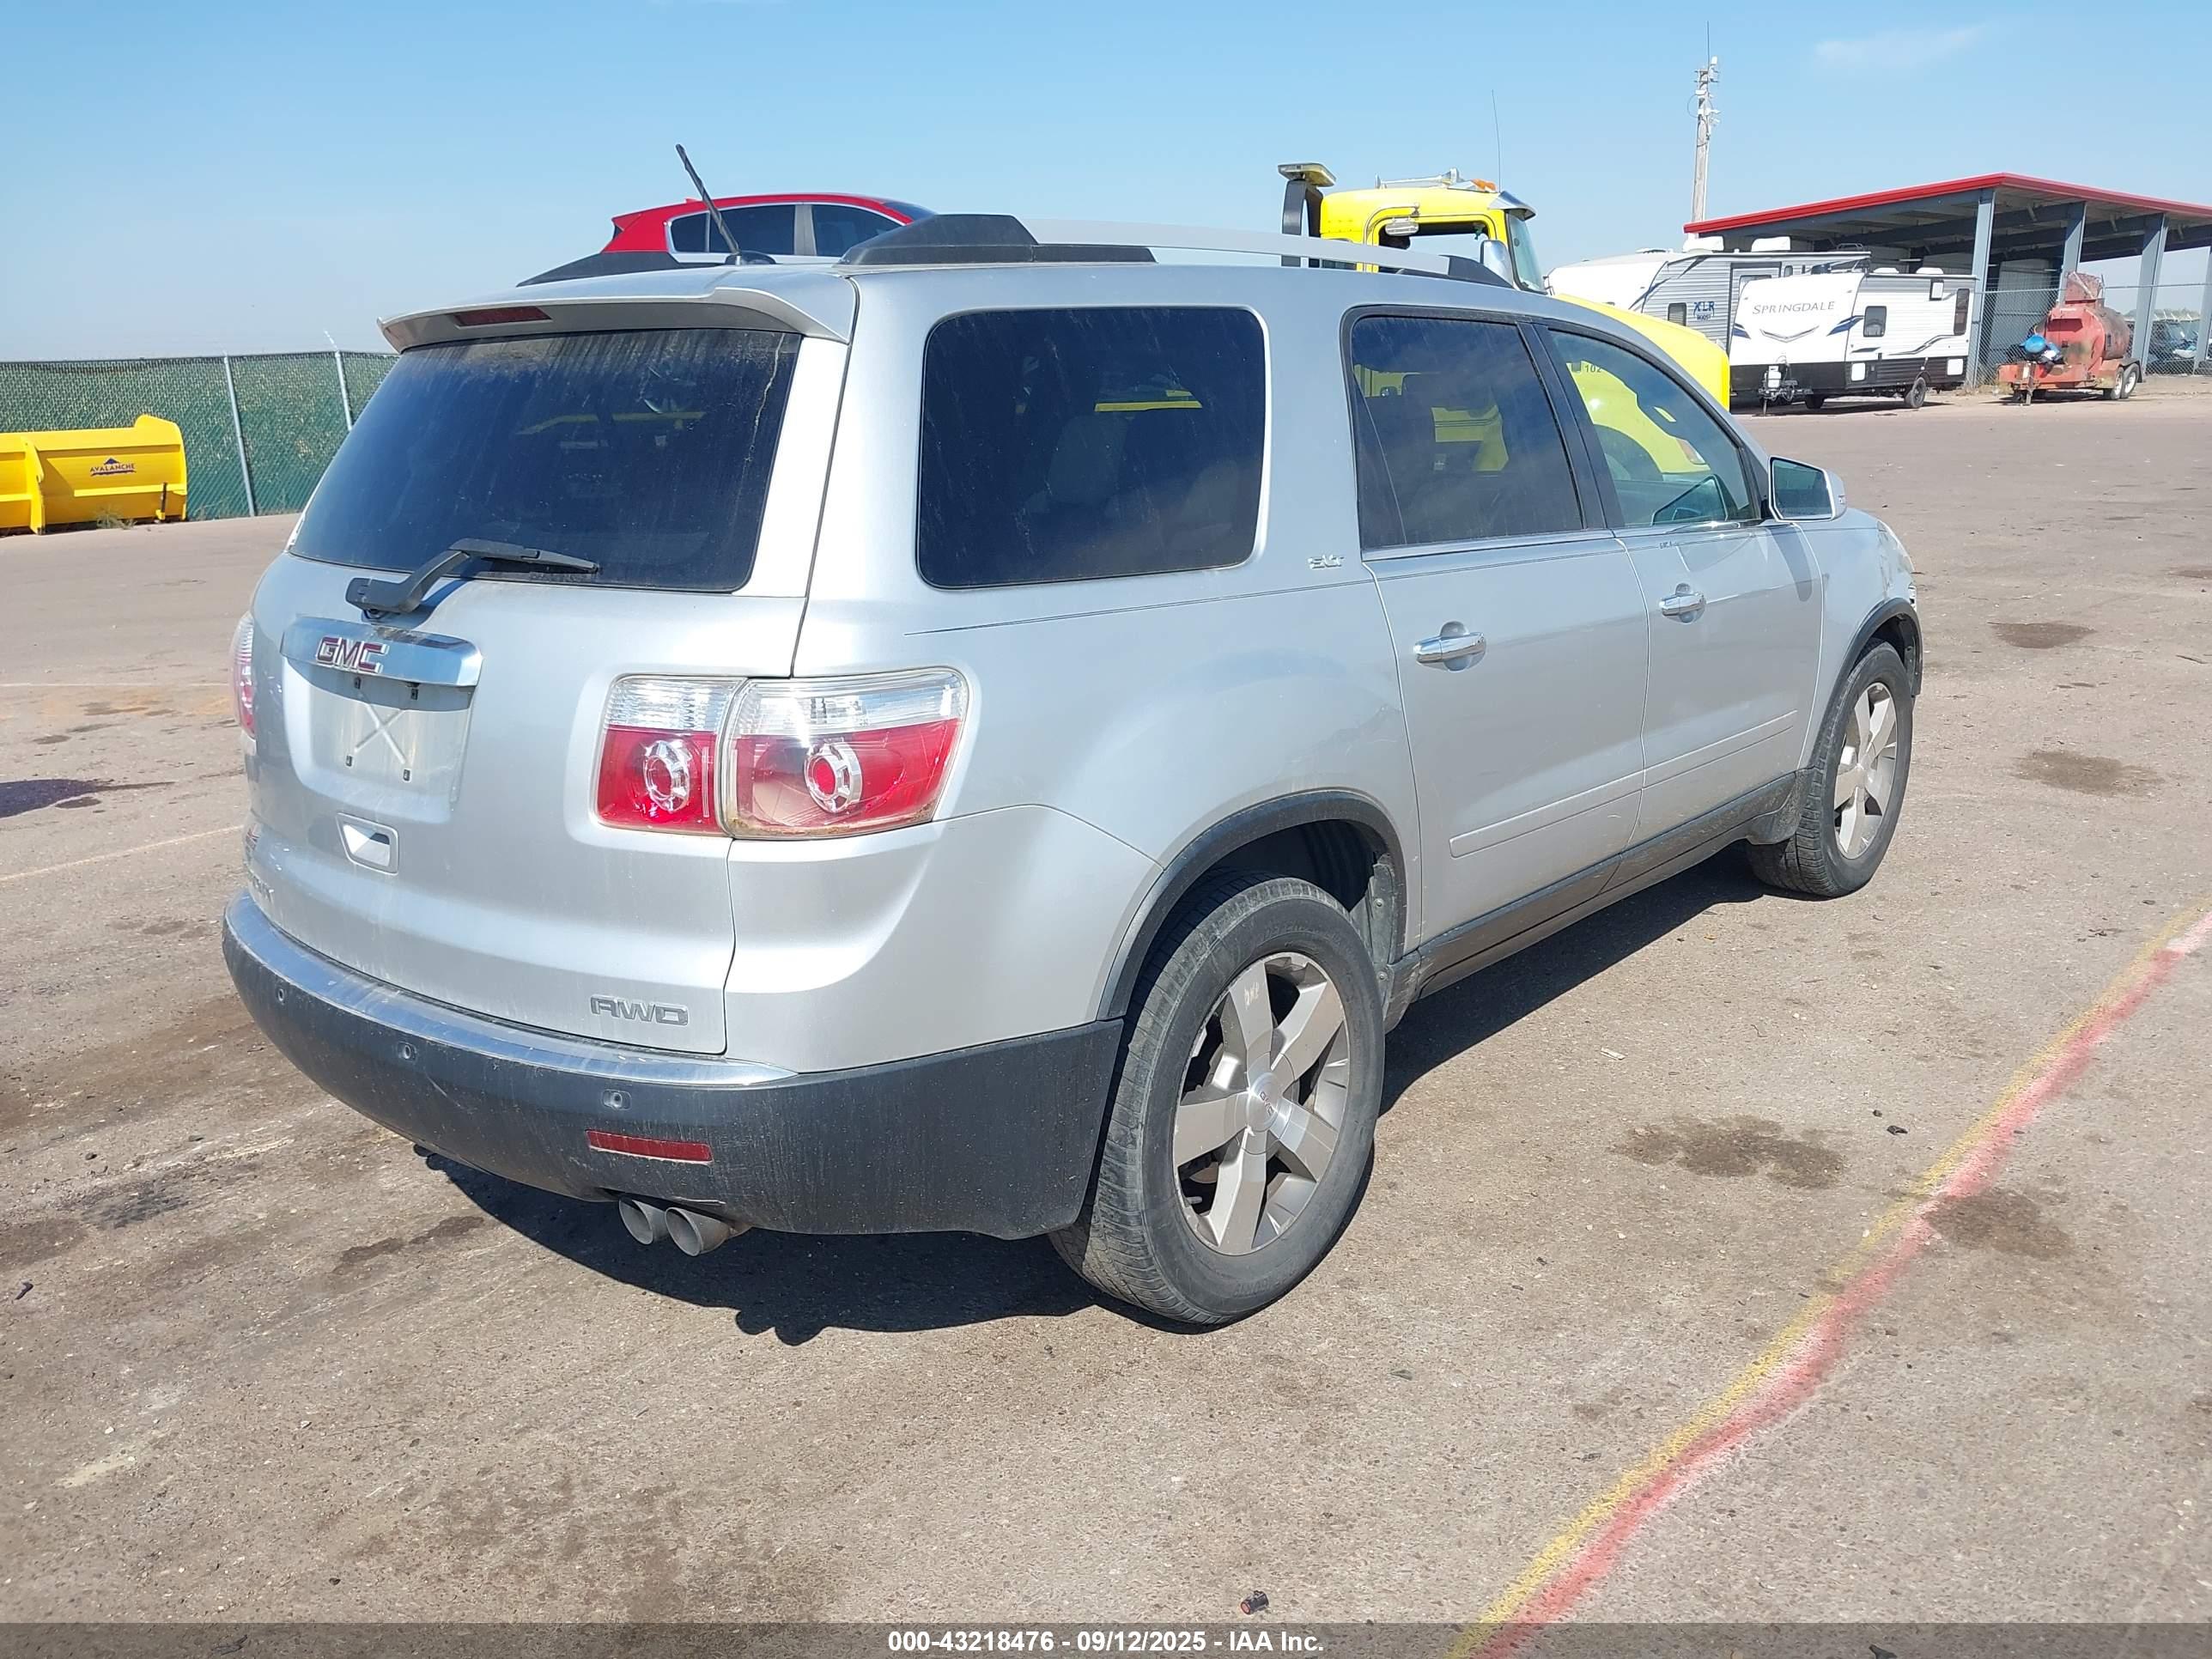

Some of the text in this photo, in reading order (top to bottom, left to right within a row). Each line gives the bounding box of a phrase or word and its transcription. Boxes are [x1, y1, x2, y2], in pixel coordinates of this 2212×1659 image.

[1693, 301, 1715, 316] XLR
[1752, 301, 1835, 315] SPRINGDALE
[90, 464, 135, 472] AVALANCHE
[316, 636, 390, 674] GMC
[590, 995, 689, 1026] AWD
